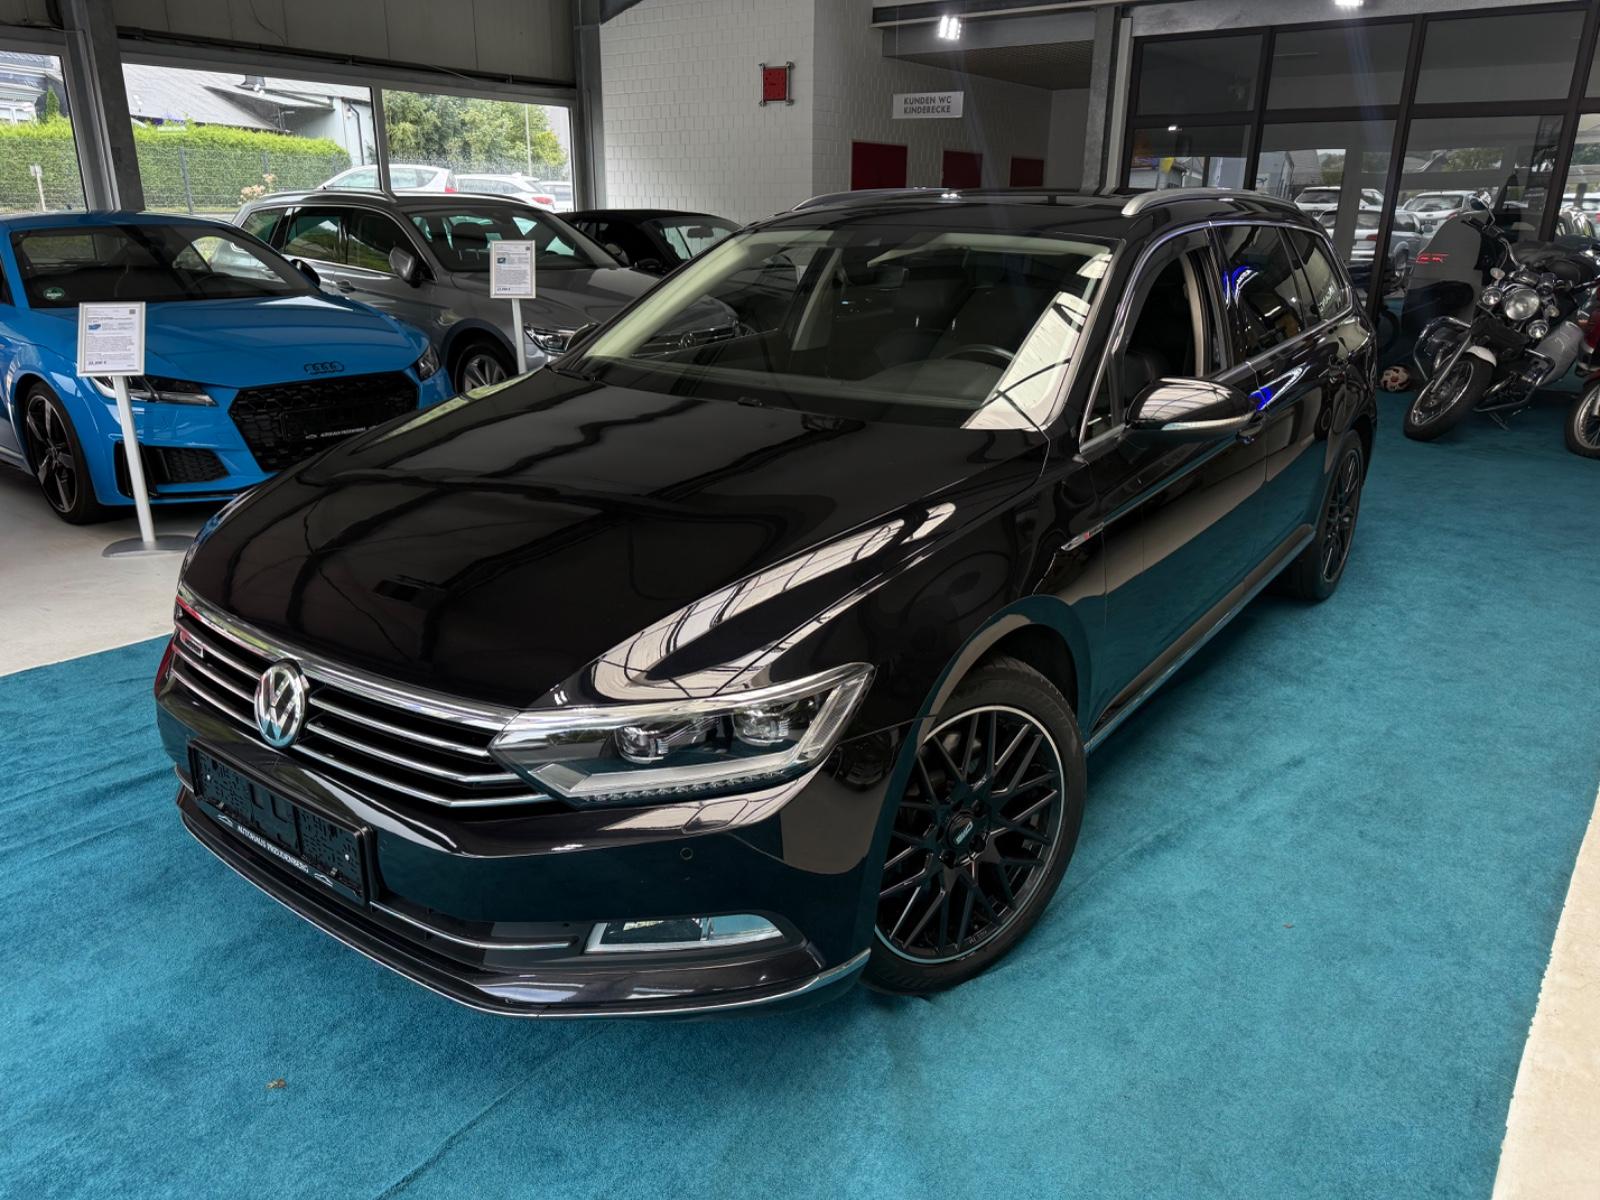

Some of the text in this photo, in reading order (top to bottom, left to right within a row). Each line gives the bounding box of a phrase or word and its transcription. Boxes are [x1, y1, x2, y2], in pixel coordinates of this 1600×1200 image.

[903, 95, 952, 105] KUNDEN WC
[903, 105, 952, 114] KINDERECKE
